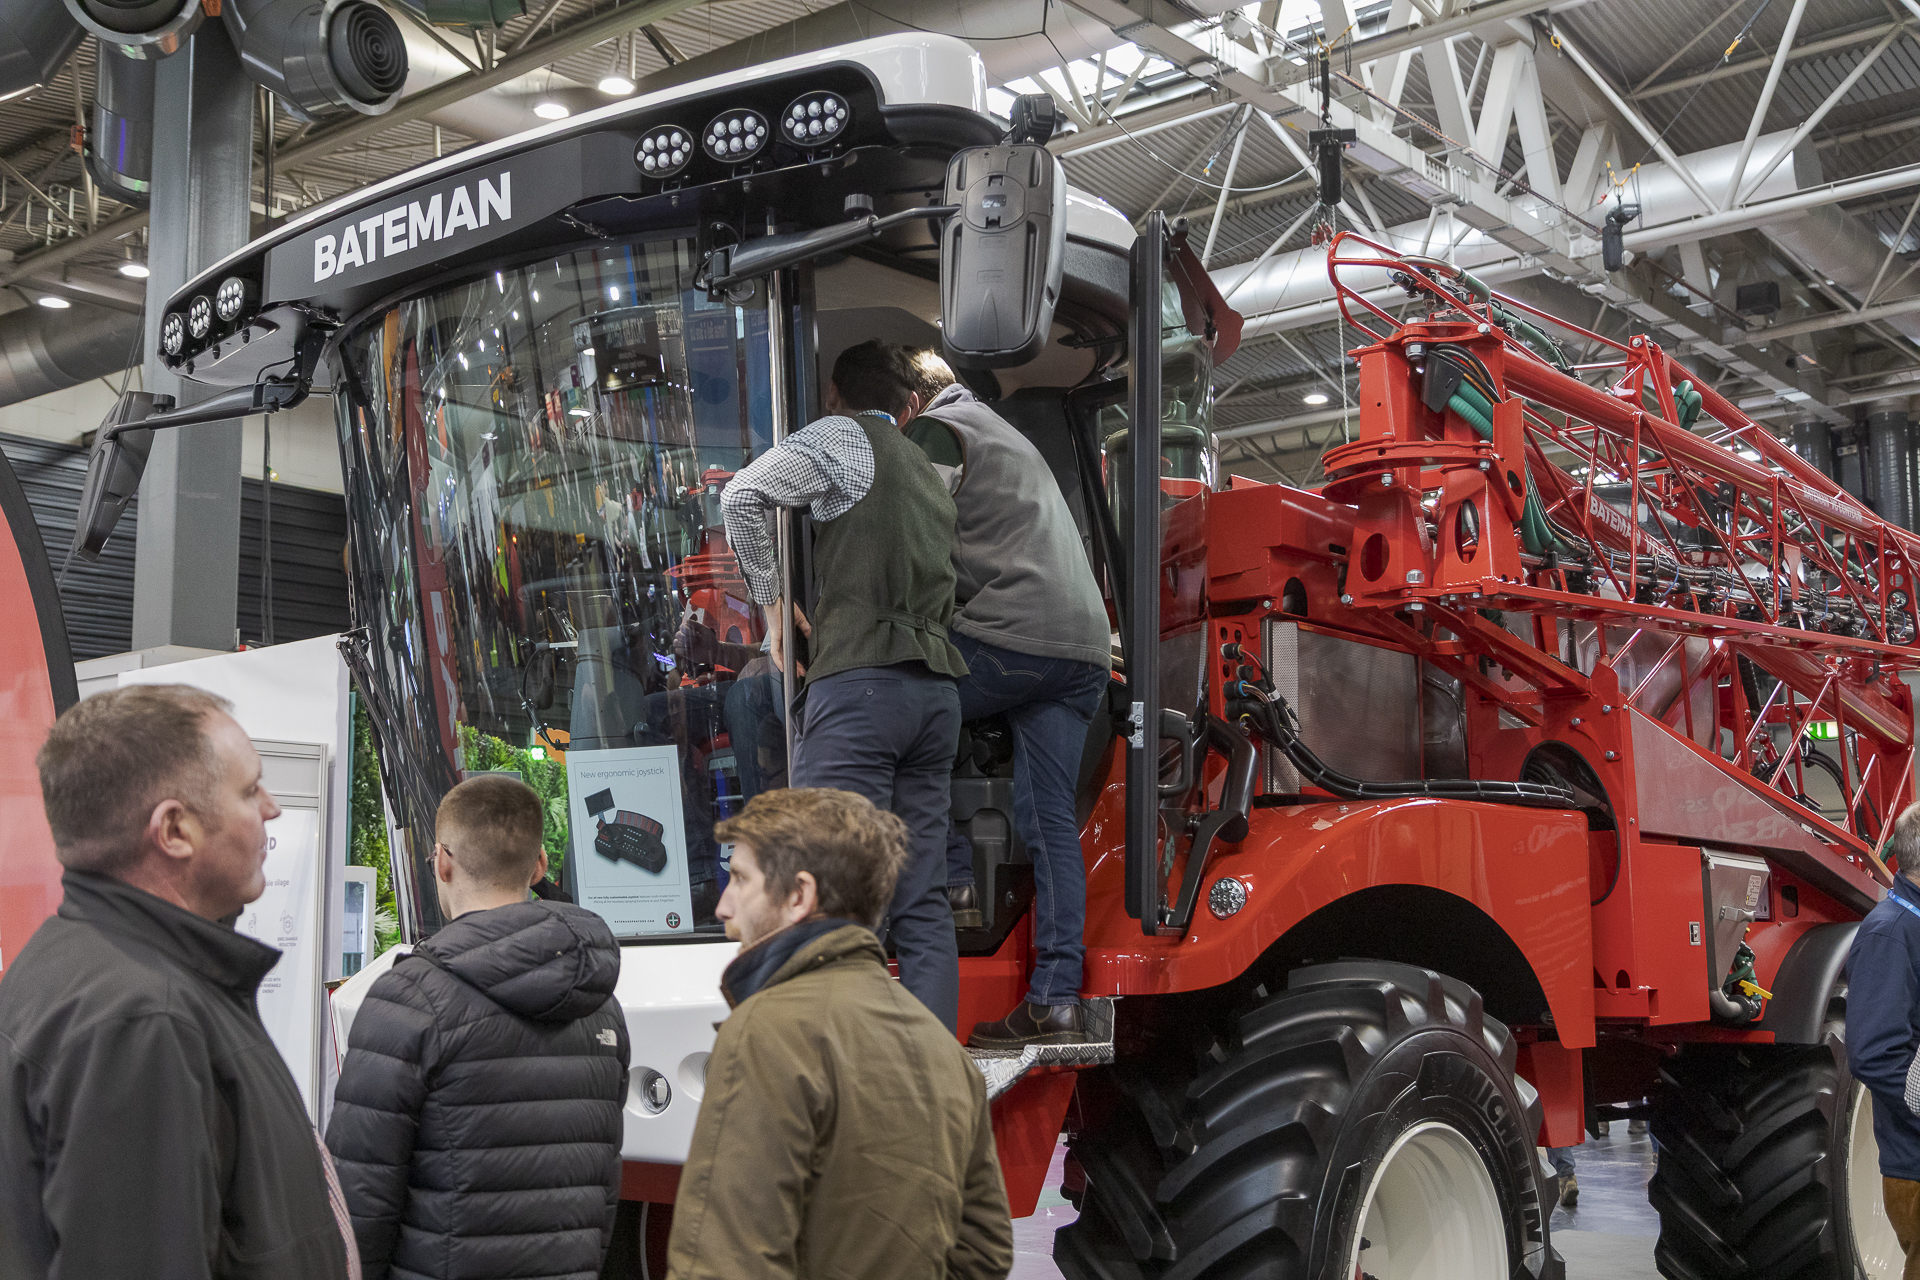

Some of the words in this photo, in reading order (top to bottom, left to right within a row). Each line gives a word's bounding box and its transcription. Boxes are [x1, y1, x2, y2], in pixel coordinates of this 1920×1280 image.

[314, 171, 512, 283] BATEMAN
[581, 771, 596, 779] New
[597, 768, 635, 779] ergonomic
[636, 767, 665, 778] joystick
[1459, 1063, 1543, 1243] MICHELIN
